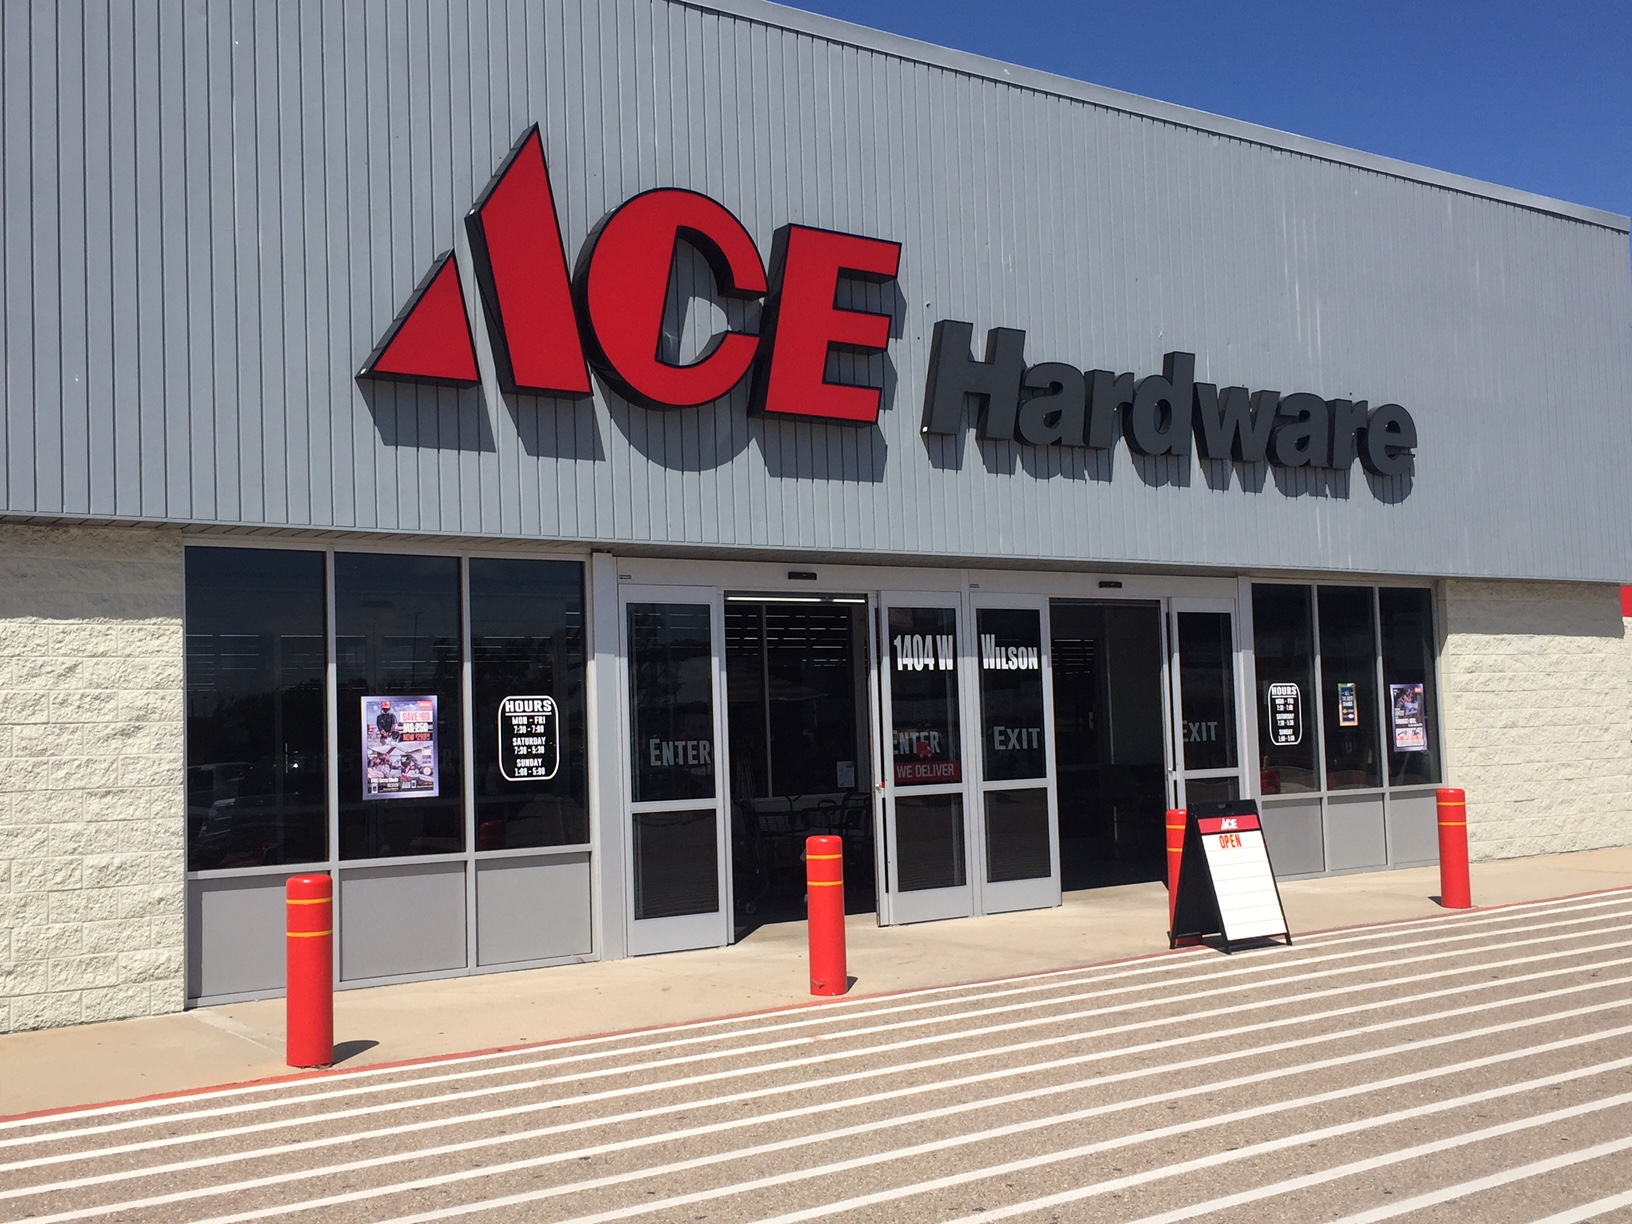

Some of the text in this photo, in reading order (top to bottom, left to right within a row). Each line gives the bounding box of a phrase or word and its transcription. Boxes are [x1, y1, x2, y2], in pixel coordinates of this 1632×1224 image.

[355, 121, 1418, 477] ACE Hardware
[894, 634, 934, 671] 1404
[936, 635, 954, 671] W
[1271, 686, 1297, 695] HOURS
[505, 700, 552, 712] HOURS
[402, 712, 418, 722] SAVE
[511, 716, 527, 725] MON
[534, 716, 546, 725] FRI
[512, 736, 546, 746] SATURDAY
[516, 758, 542, 767] SUNDAY
[897, 763, 954, 778] WE DELIVER
[1221, 818, 1238, 830] ACE
[1218, 833, 1242, 849] OPEN
